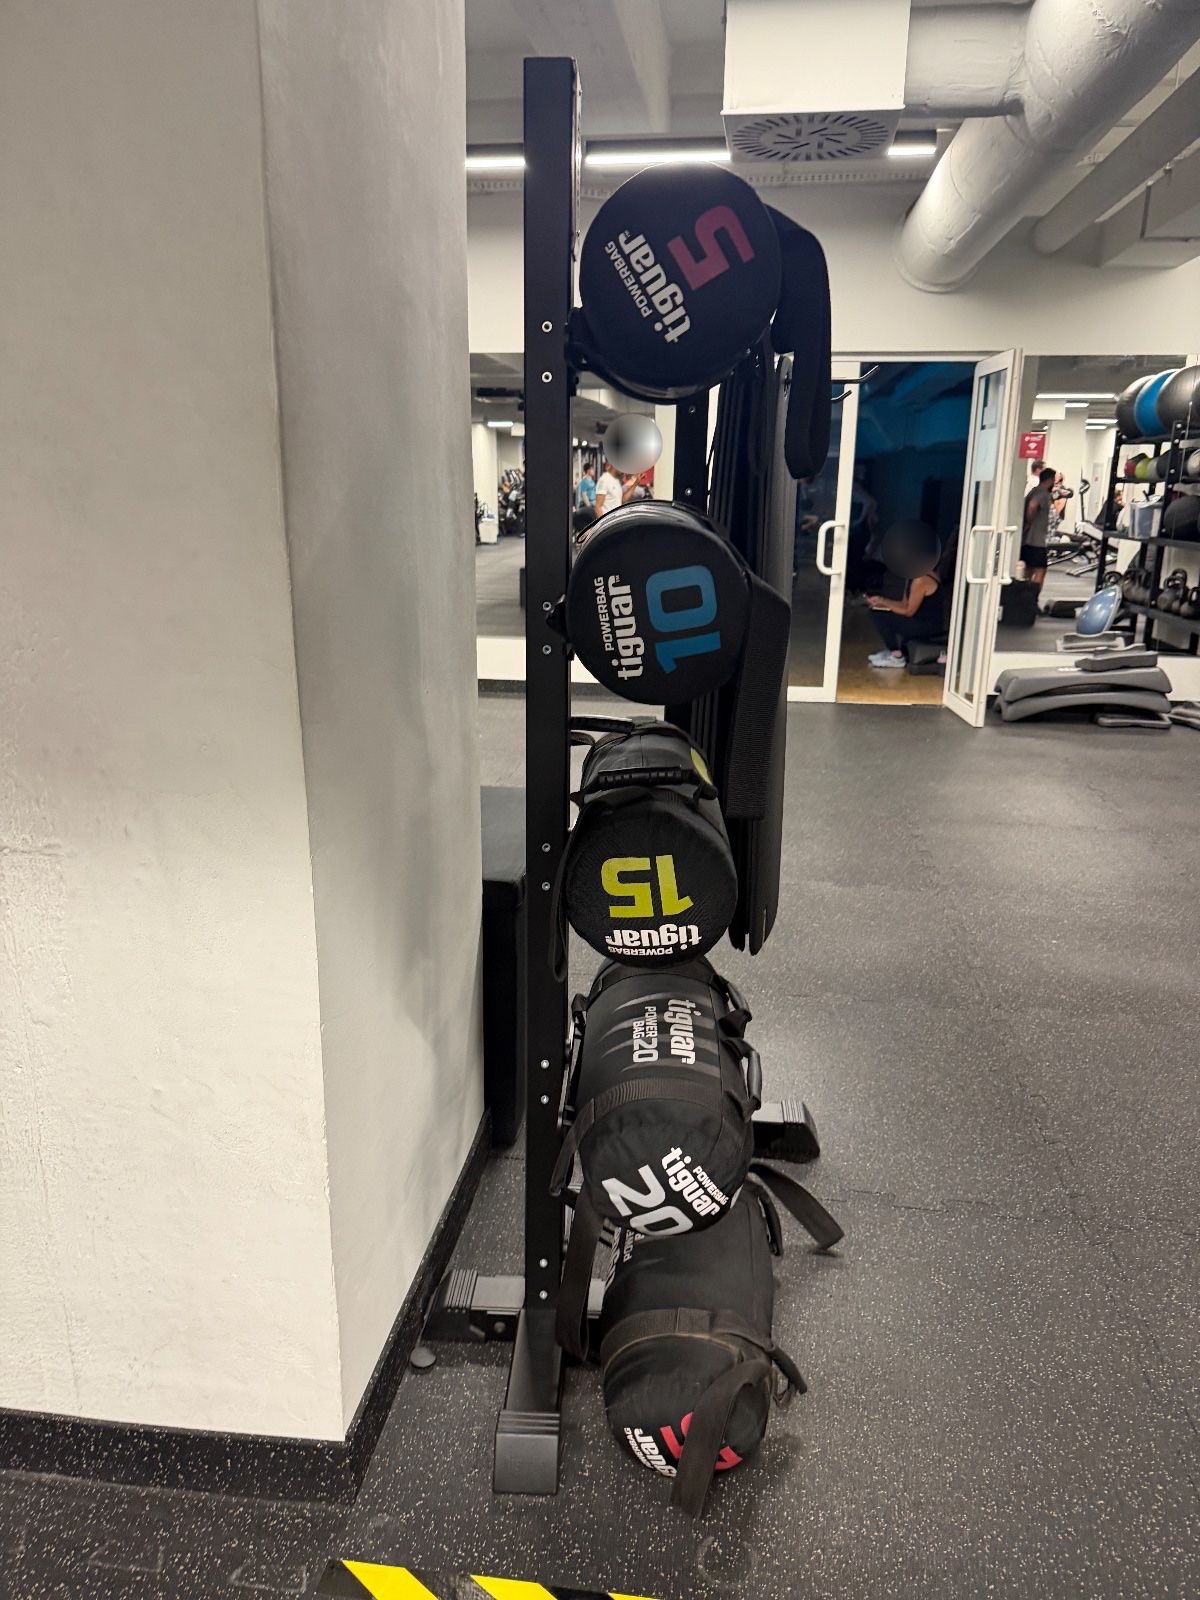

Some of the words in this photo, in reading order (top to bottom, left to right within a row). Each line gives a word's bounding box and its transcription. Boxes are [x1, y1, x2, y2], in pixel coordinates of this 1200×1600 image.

[604, 240, 653, 318] POWERBAG
[666, 204, 755, 291] 5
[618, 232, 691, 344] tiguar
[594, 576, 615, 652] POWERBAG
[608, 575, 645, 681] tiguar
[645, 564, 721, 674] 10
[601, 854, 694, 919] 15
[605, 923, 702, 951] tiguar
[608, 945, 674, 956] POWERBAG
[632, 1020, 645, 1039] BAG
[632, 1037, 659, 1063] 20
[644, 1006, 658, 1038] POWER
[663, 999, 702, 1065] tiguar
[601, 1164, 694, 1237] 20
[661, 1146, 721, 1217] tiguar
[692, 1165, 730, 1206] POWERBAG
[622, 1229, 636, 1263] POWE
[633, 1427, 678, 1478] guar
